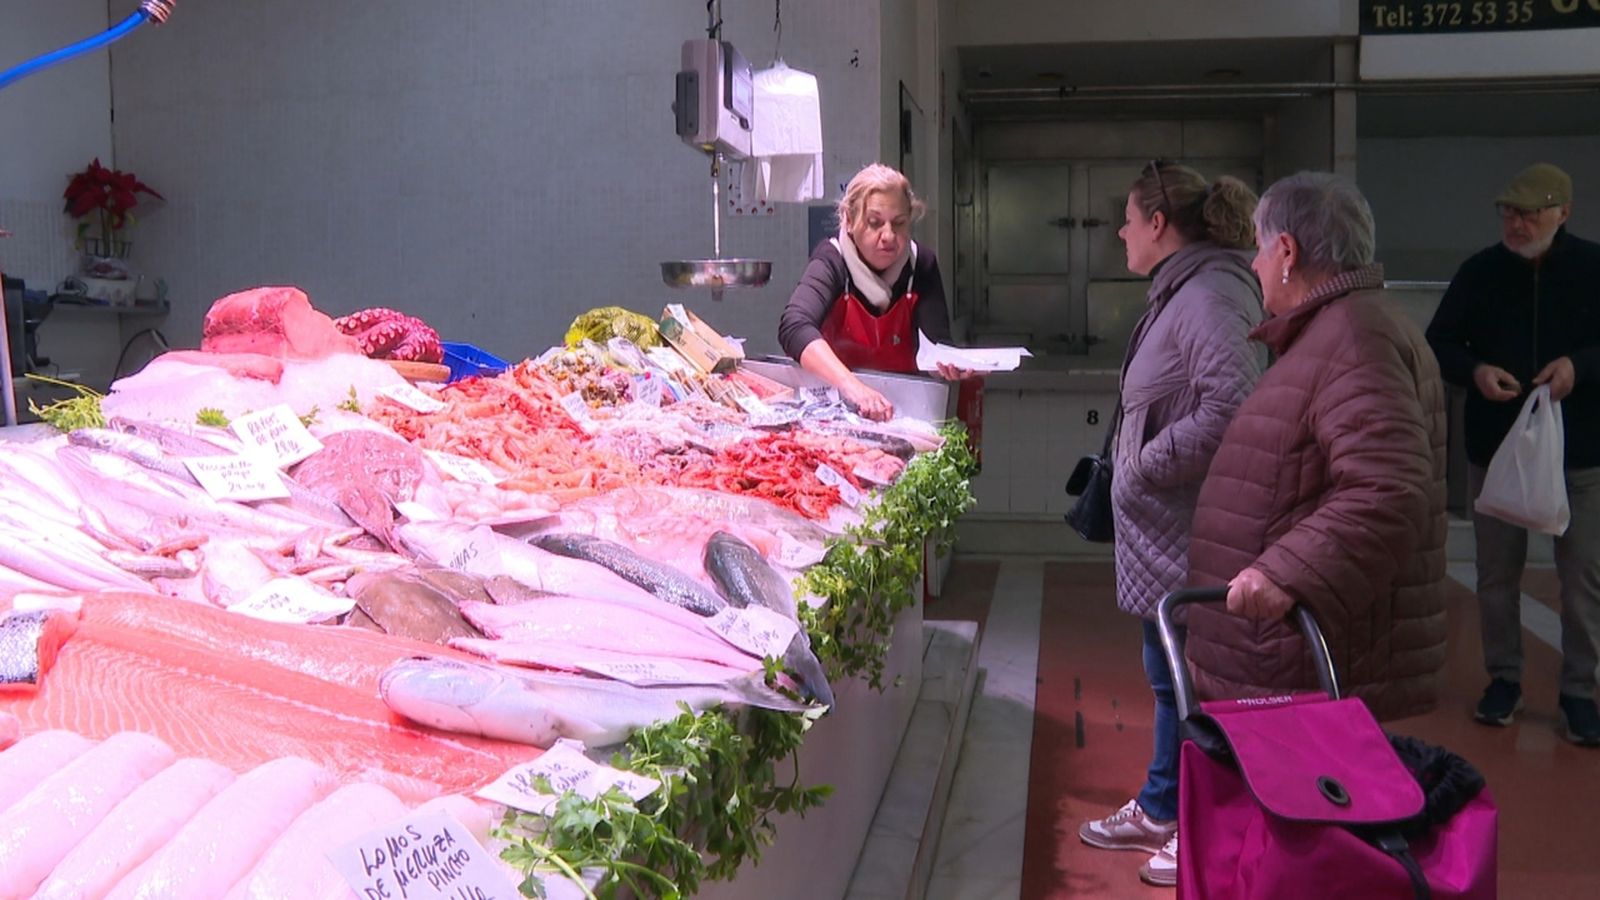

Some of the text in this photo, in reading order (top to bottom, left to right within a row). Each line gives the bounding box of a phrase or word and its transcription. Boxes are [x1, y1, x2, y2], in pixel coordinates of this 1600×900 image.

[1373, 4, 1413, 28] Tel:
[1422, 3, 1462, 26] 372
[1471, 2, 1497, 25] 53
[1505, 1, 1534, 23] 35
[1087, 410, 1099, 425] 8
[1246, 695, 1293, 706] ROLSER
[360, 825, 422, 877] LOMOS
[427, 849, 470, 893] PINCHO
[364, 878, 391, 900] DE
